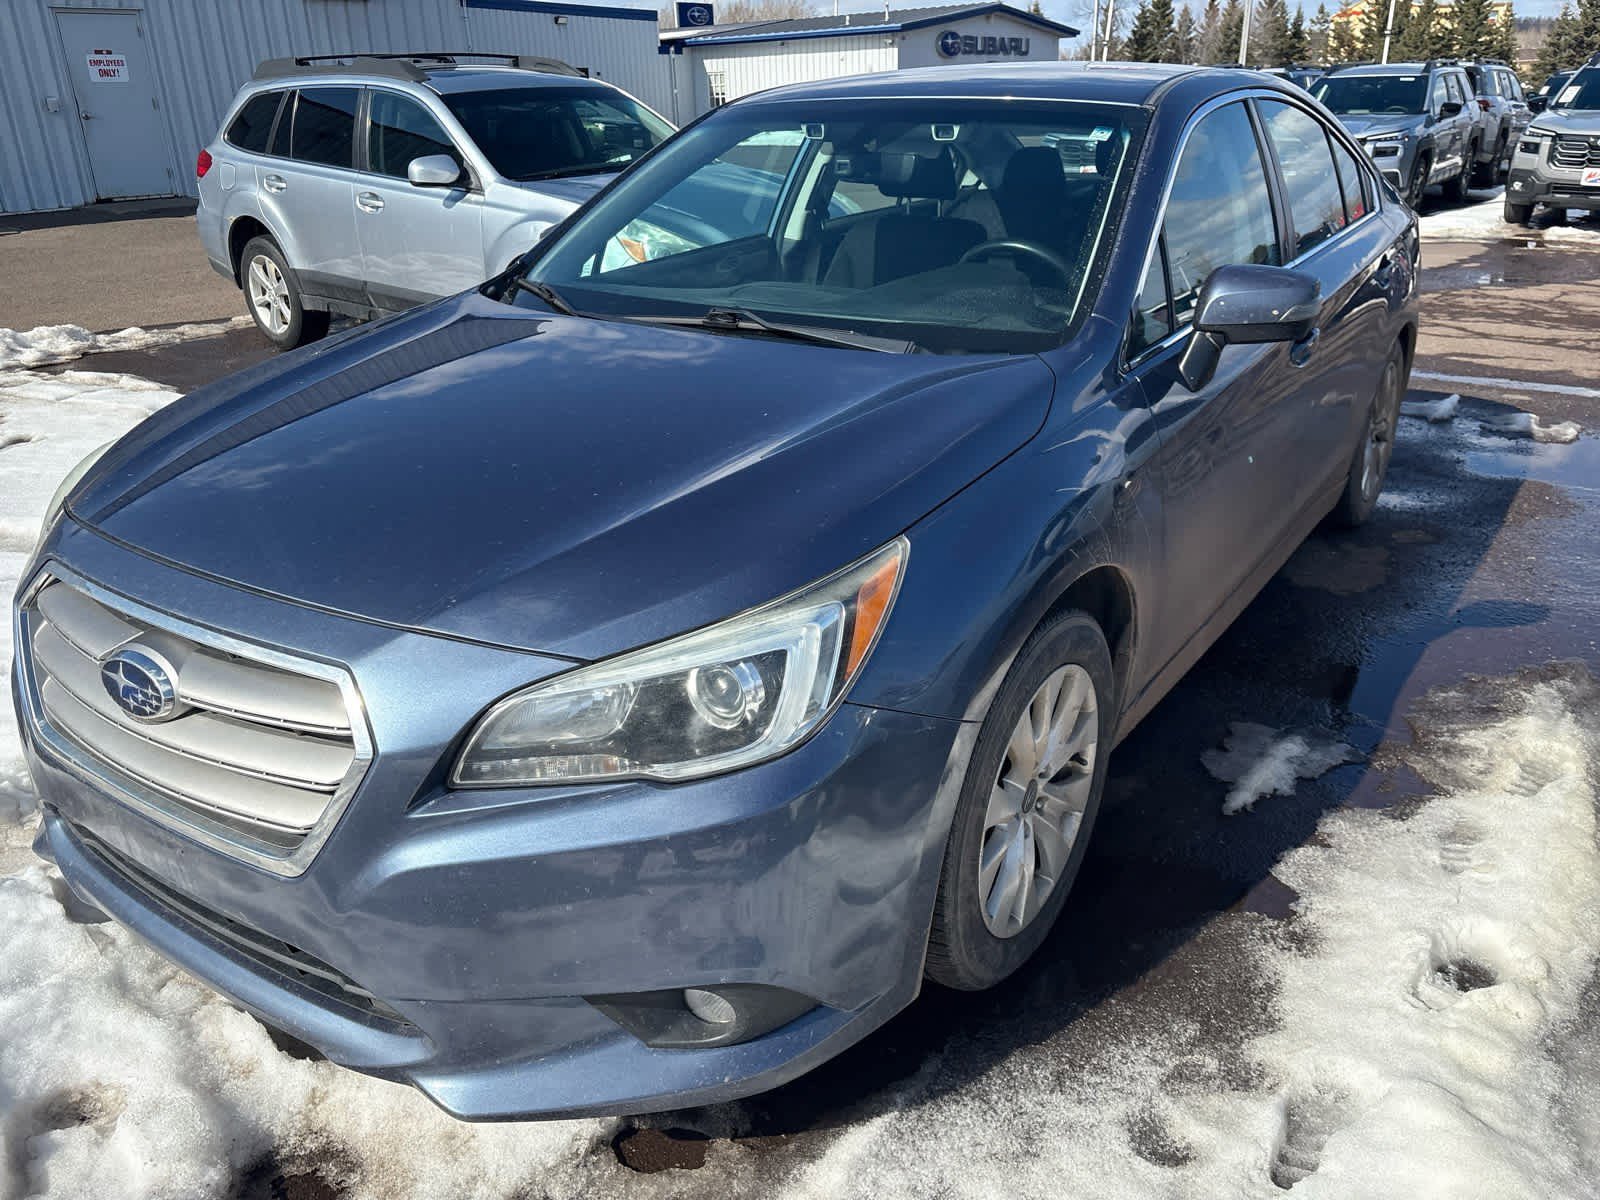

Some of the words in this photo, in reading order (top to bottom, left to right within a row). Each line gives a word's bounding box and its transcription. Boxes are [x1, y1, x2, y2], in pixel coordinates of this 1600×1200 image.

[960, 34, 1030, 57] SUBARU
[88, 59, 125, 67] EMPLOYEES
[98, 68, 121, 78] ONLY!
